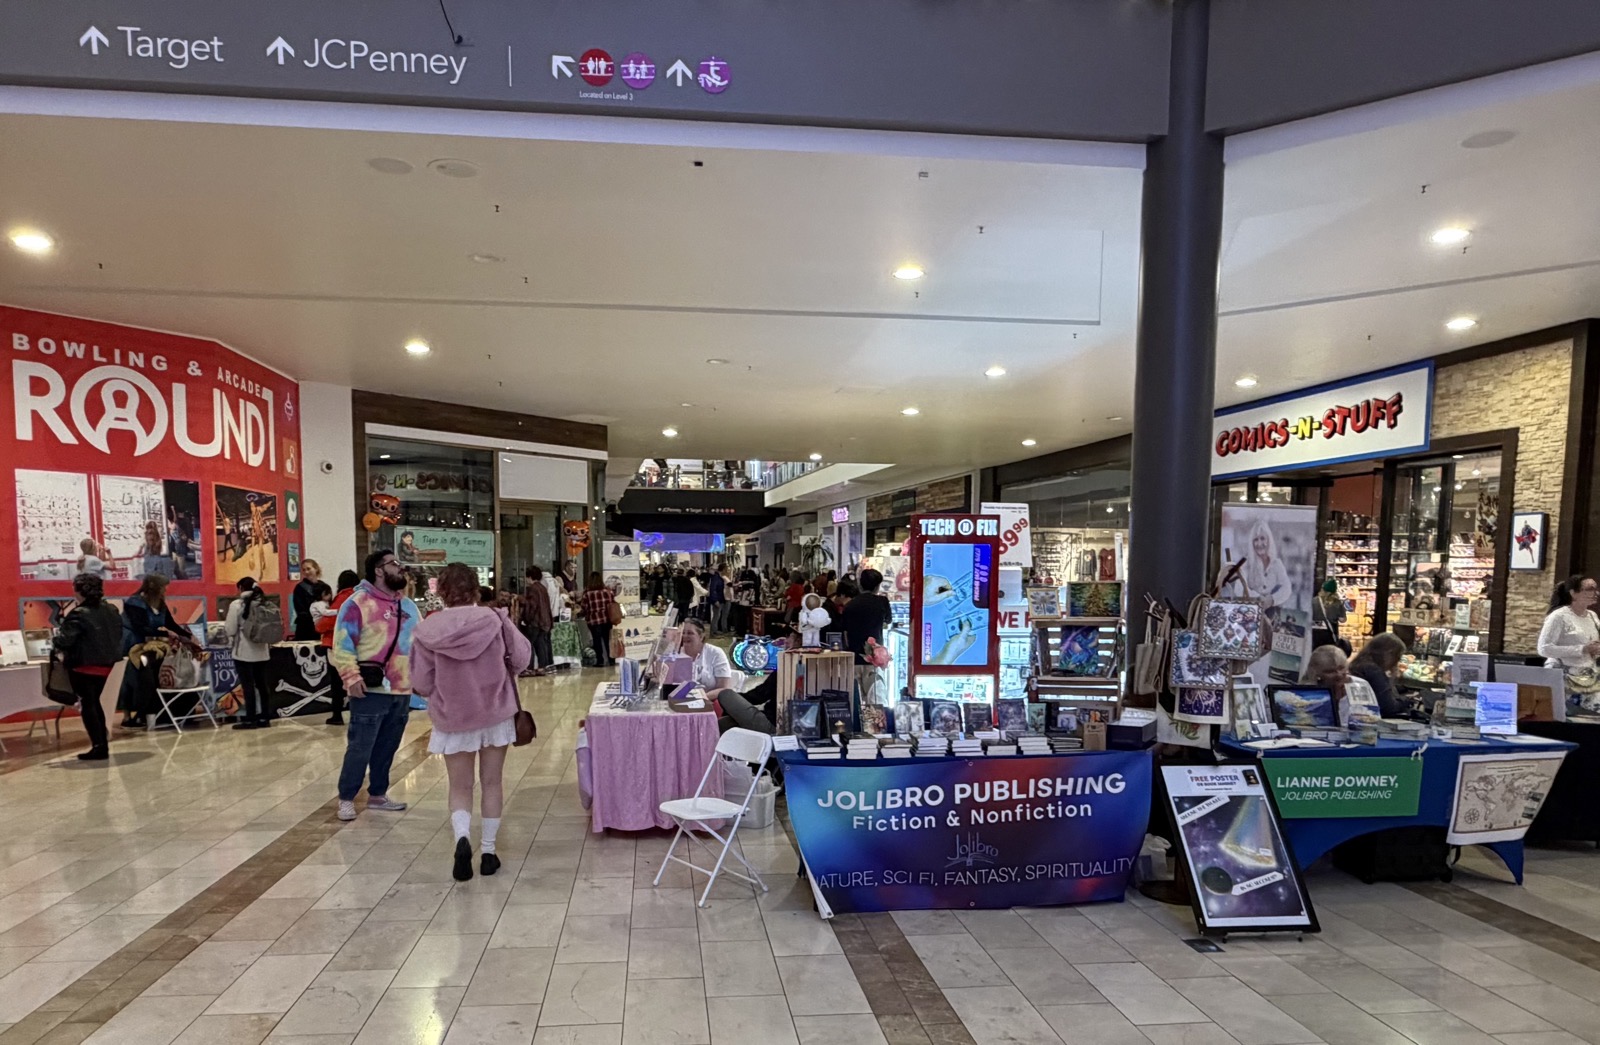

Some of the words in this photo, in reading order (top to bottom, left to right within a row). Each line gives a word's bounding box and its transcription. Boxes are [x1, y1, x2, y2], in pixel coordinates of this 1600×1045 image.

[116, 26, 224, 69] Target
[303, 38, 467, 84] JCPenney
[579, 91, 604, 99] Located
[612, 92, 628, 100] Level
[12, 333, 168, 371] BOWLING
[187, 360, 203, 376] &
[217, 366, 261, 398] ARCADE
[1215, 391, 1403, 457] COMICS-N-STUFF
[422, 534, 439, 546] Tiger
[440, 536, 447, 544] in
[449, 536, 460, 547] My
[463, 536, 487, 547] Tummy
[919, 519, 956, 536] TECH
[976, 519, 998, 536] FIX
[213, 665, 239, 688] joy
[817, 784, 945, 811] JOLIBRO
[954, 772, 1127, 804] PUBLISHING
[1190, 775, 1209, 783] FREE
[1276, 776, 1332, 789] LIANNE
[1333, 775, 1399, 789] DOWNEY,
[1281, 790, 1328, 801] JOLIBRO
[1330, 789, 1393, 800] PUBLISHING
[853, 815, 936, 832] Fiction
[946, 810, 961, 827] &
[970, 801, 1093, 826] Nonfiction
[946, 832, 999, 860] Jolibro
[883, 869, 912, 885] SCI
[919, 872, 938, 886] FI,
[944, 866, 1021, 885] FANTASY,
[1025, 855, 1136, 881] SPIRITUALITY
